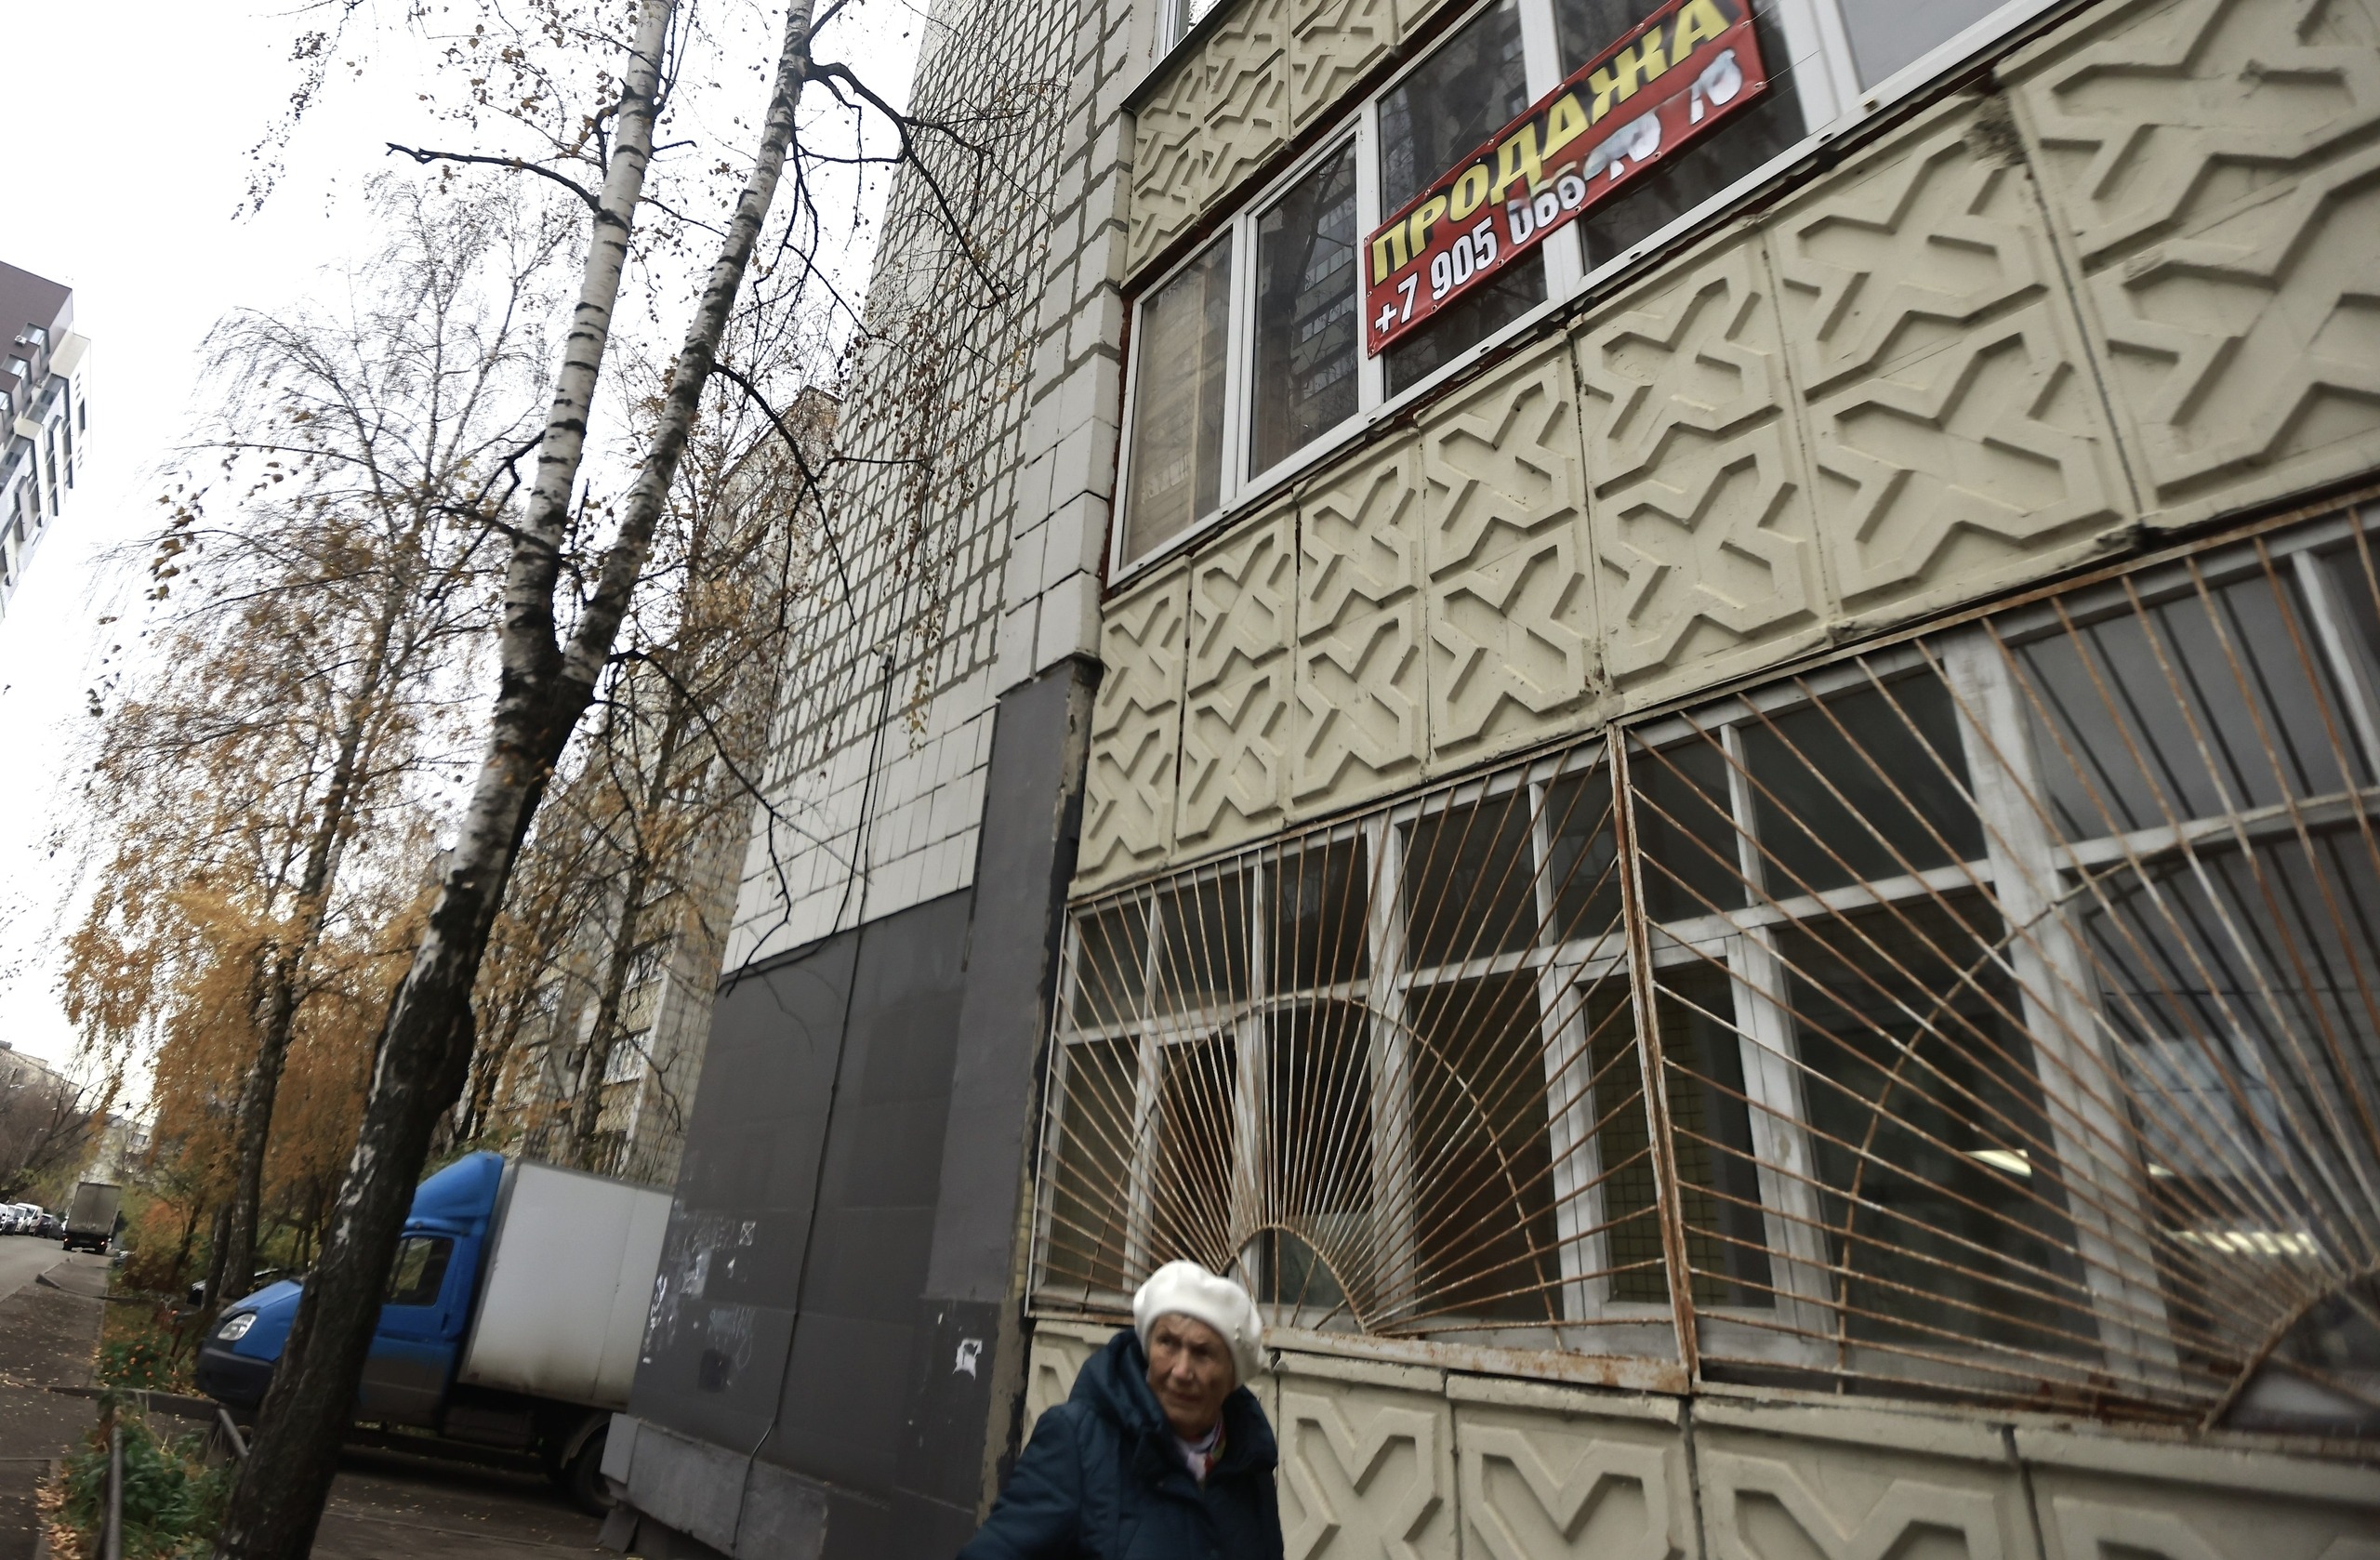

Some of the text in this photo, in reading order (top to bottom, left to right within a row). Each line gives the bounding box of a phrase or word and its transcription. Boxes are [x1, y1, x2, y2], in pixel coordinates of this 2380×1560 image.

[1373, 0, 1730, 286] ПРОДАЖА
[1375, 272, 1419, 333] +7
[1431, 217, 1498, 300] 905
